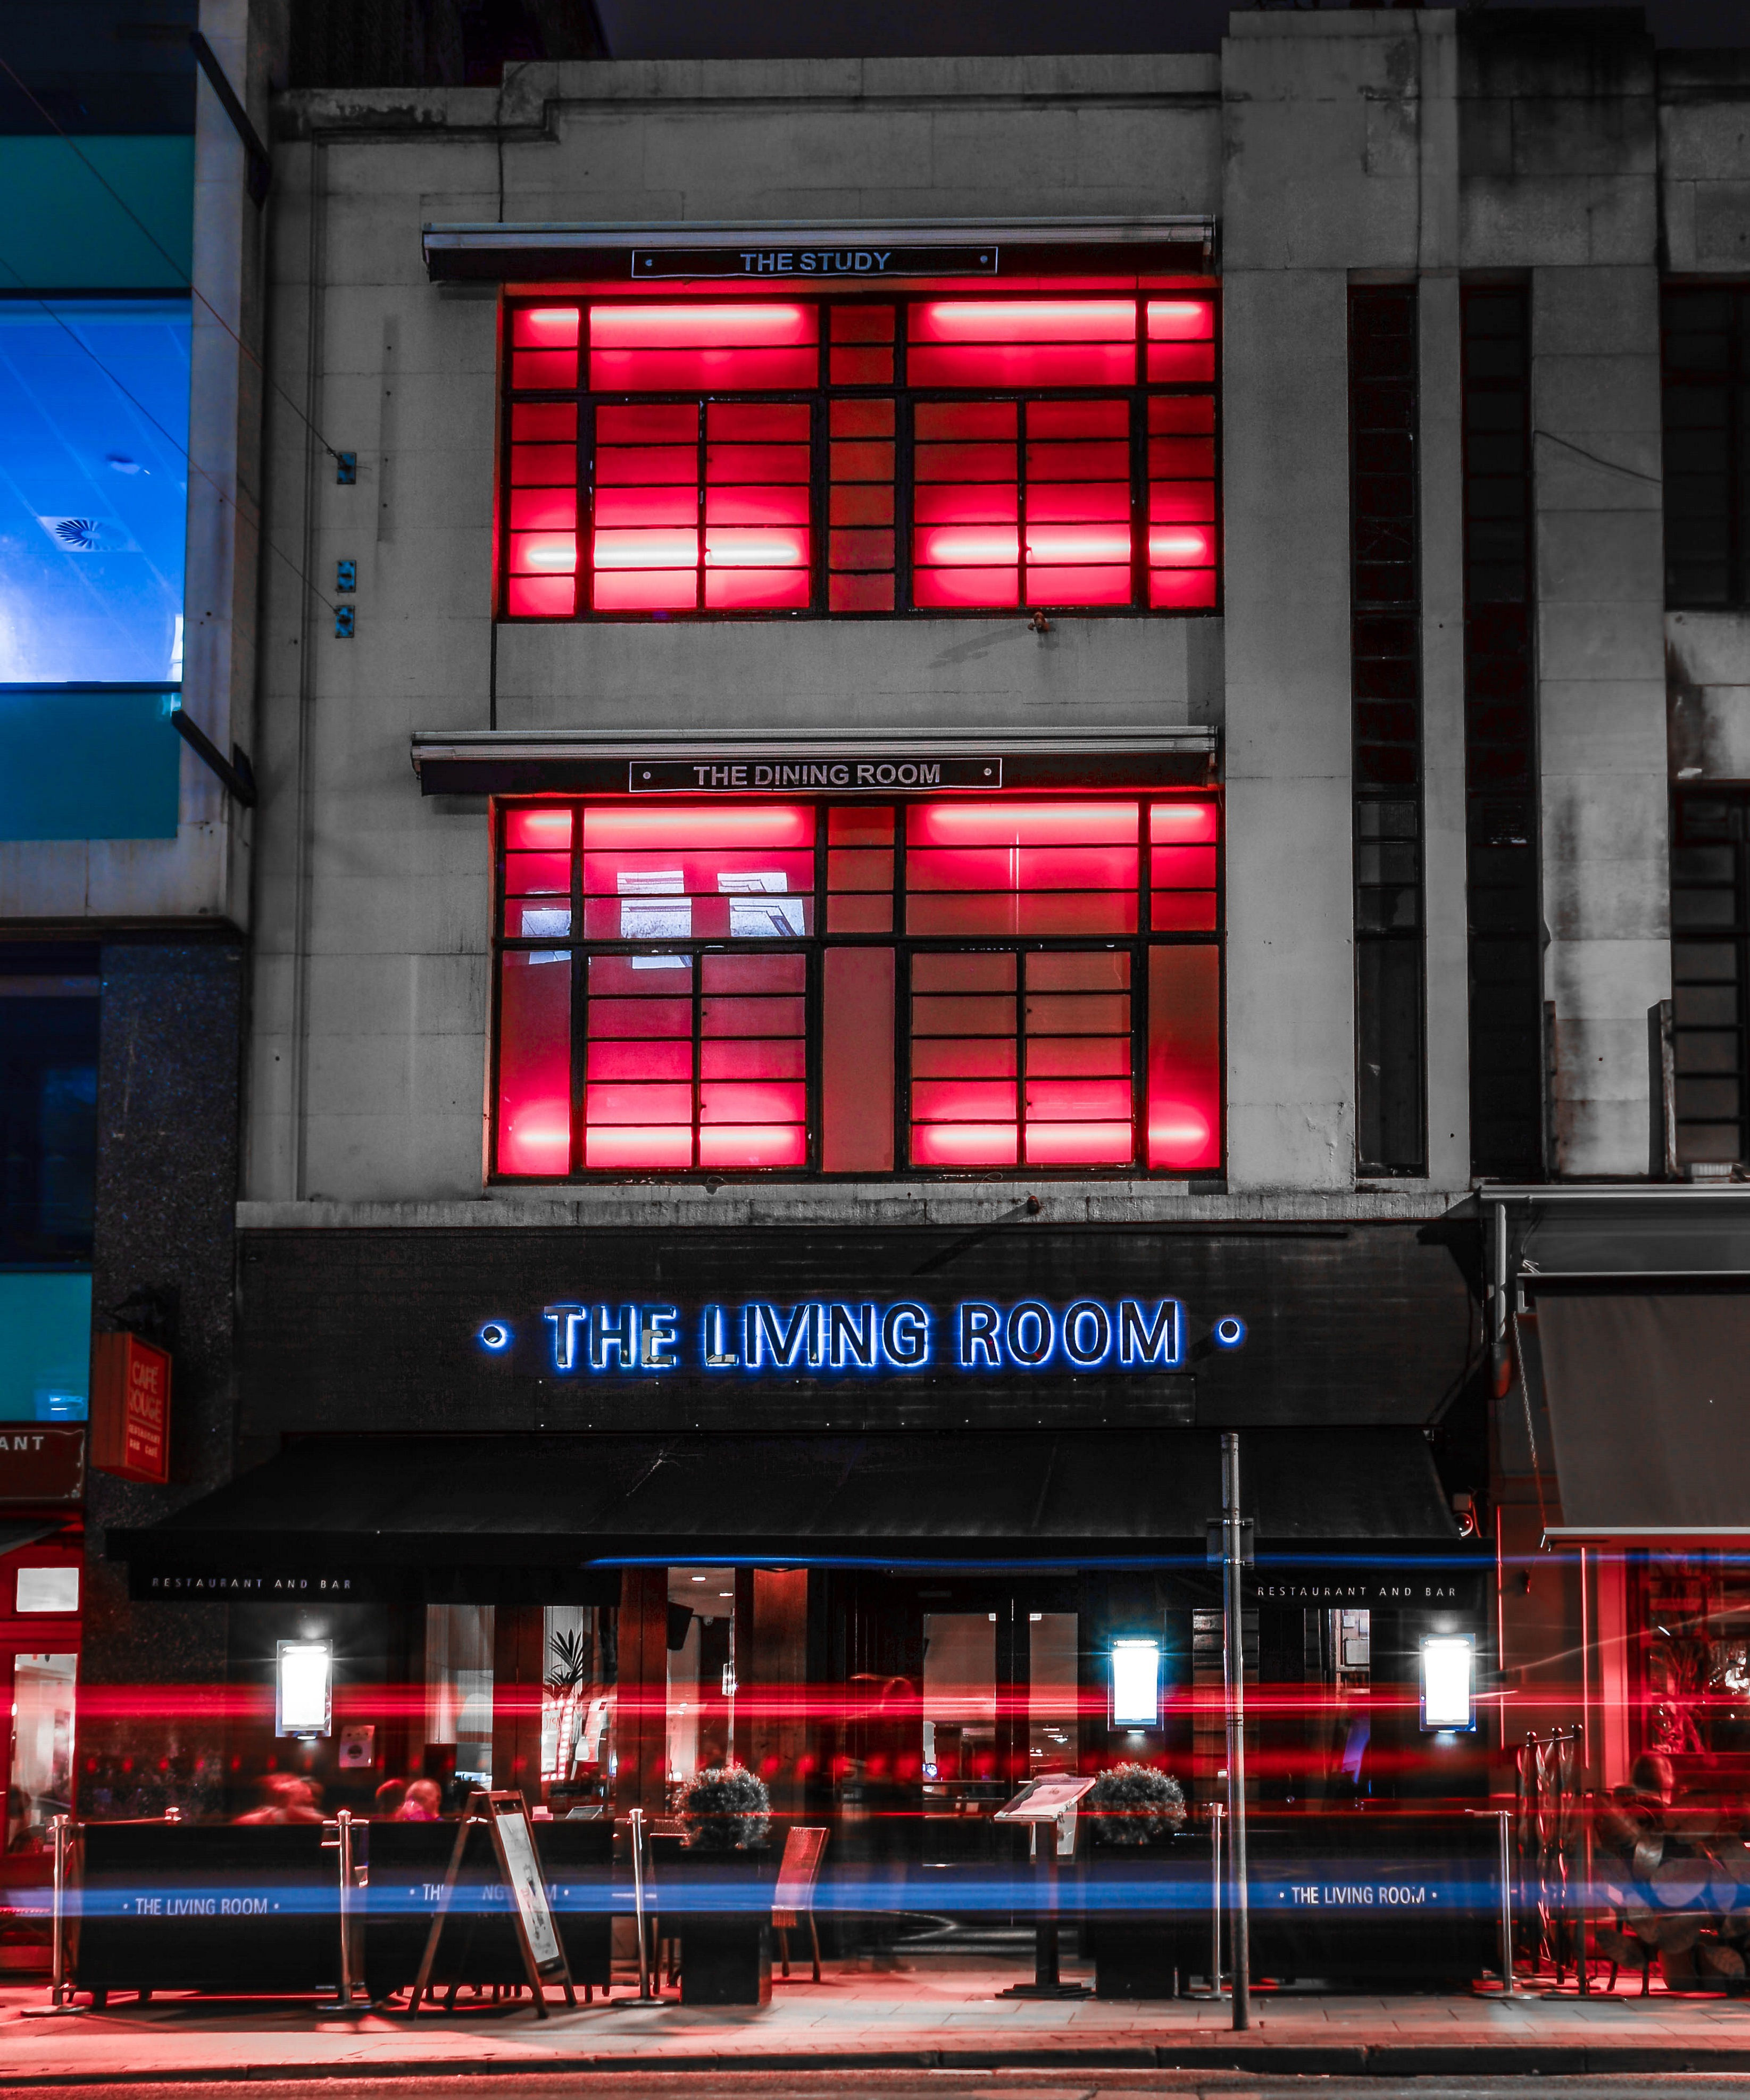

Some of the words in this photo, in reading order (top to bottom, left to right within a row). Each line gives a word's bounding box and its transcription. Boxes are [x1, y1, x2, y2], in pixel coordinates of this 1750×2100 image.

[740, 252, 793, 271] THE
[799, 252, 891, 271] STUDY
[693, 766, 747, 786] THE
[755, 765, 849, 785] DINING
[857, 764, 940, 784] ROOM
[544, 1305, 677, 1366] THE
[705, 1303, 927, 1366] LIVING
[960, 1301, 1178, 1366] ROOM
[129, 1386, 162, 1423] ROUGE
[152, 1578, 262, 1588] RESTAURANT
[274, 1579, 307, 1588] AND
[320, 1580, 351, 1589] BAR
[1258, 1587, 1366, 1596] RESTAURANT
[1379, 1587, 1411, 1596] AND
[1426, 1588, 1455, 1596] BAR
[423, 1884, 448, 1901] TH
[1291, 1887, 1319, 1904] THE
[1325, 1887, 1373, 1904] LIVING
[1379, 1887, 1425, 1904] ROOM
[135, 1898, 162, 1915] THE
[167, 1898, 215, 1915] LIVING
[221, 1898, 268, 1914] ROOM
